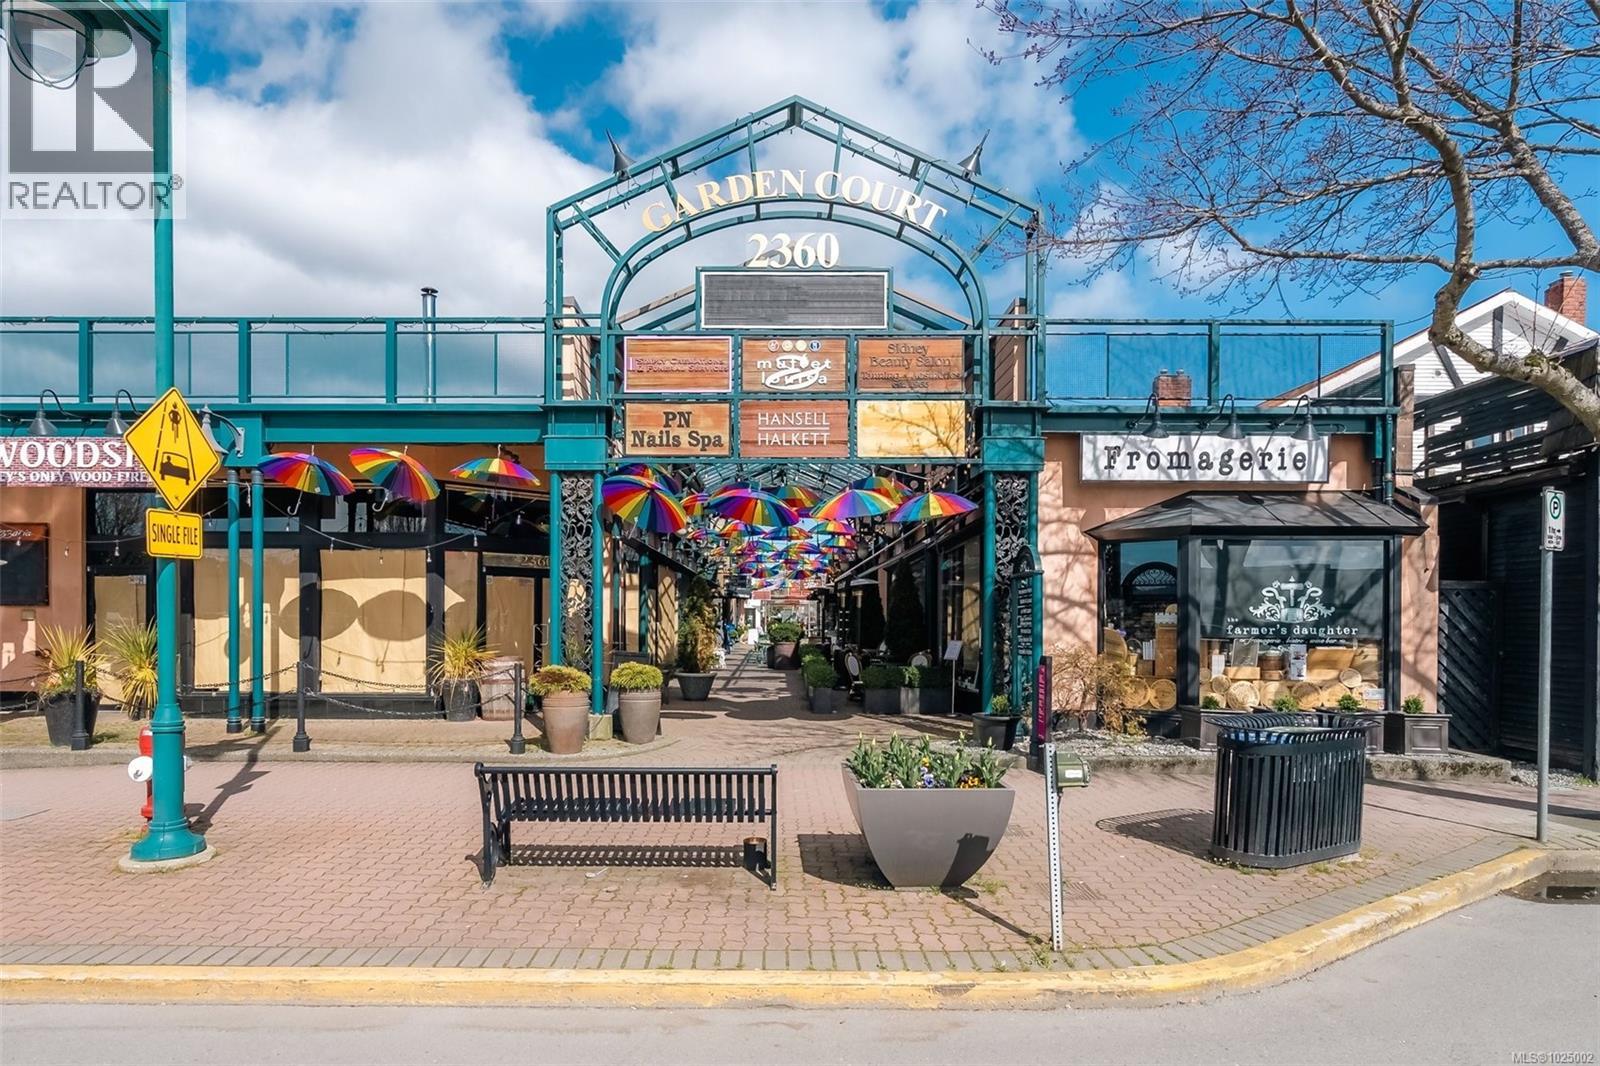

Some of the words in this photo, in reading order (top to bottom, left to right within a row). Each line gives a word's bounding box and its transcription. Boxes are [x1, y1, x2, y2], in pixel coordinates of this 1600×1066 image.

[641, 169, 805, 232] GARDEN
[814, 170, 947, 232] COURT
[747, 232, 840, 269] 2360
[887, 343, 929, 356] Sidney
[869, 357, 912, 369] Beauty
[916, 356, 951, 367] Salon
[663, 411, 692, 428] PN
[758, 412, 830, 426] HANSELL
[631, 430, 681, 447] Nails
[688, 431, 723, 451] Spa
[758, 433, 830, 446] HALKETT
[0, 441, 140, 469] WOODSI
[1103, 445, 1307, 476] Fromagerie
[30, 471, 68, 482] ONLY
[71, 471, 153, 482] WOOD-FIRE
[1553, 501, 1559, 513] P
[152, 523, 181, 545] SINGLE
[183, 527, 198, 545] FILE
[1226, 625, 1287, 635] farmer's
[1293, 625, 1358, 637] daughter
